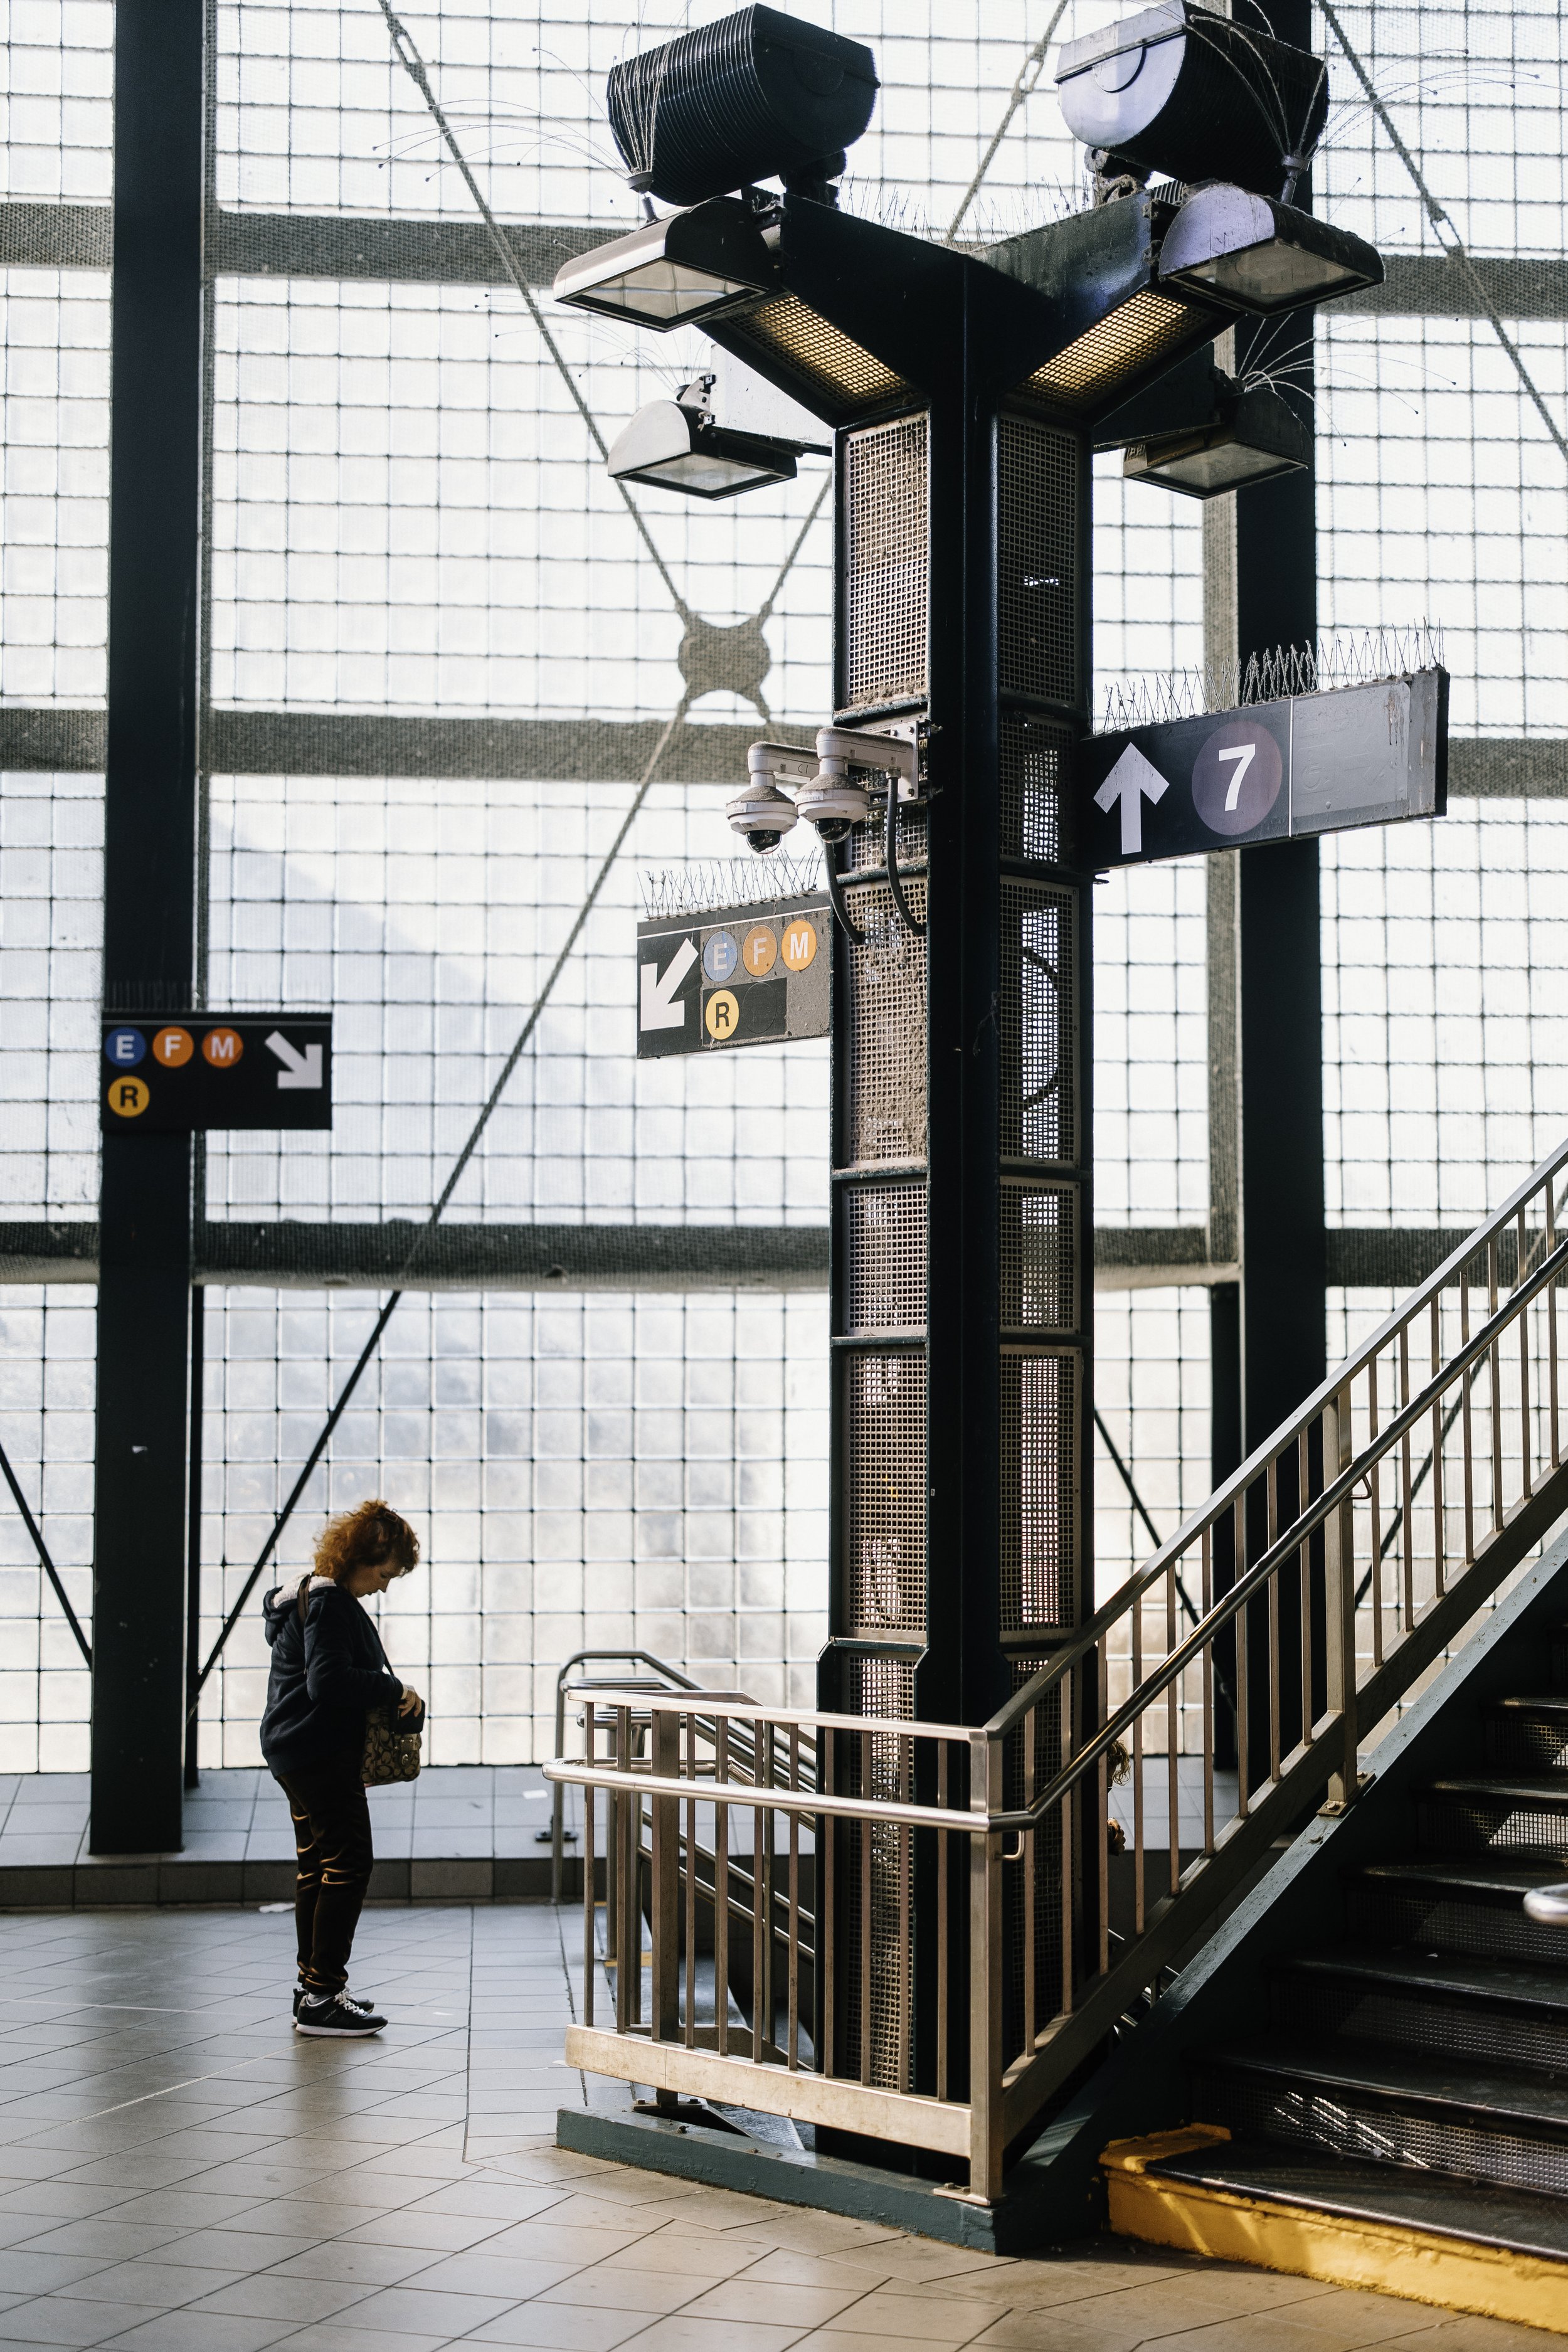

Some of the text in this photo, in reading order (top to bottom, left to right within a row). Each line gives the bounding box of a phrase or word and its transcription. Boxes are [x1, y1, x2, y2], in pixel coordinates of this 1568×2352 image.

[1219, 744, 1256, 811] 7
[714, 931, 808, 970] E F M
[716, 1002, 729, 1028] R
[117, 1035, 234, 1059] E F M
[120, 1085, 138, 1108] R
